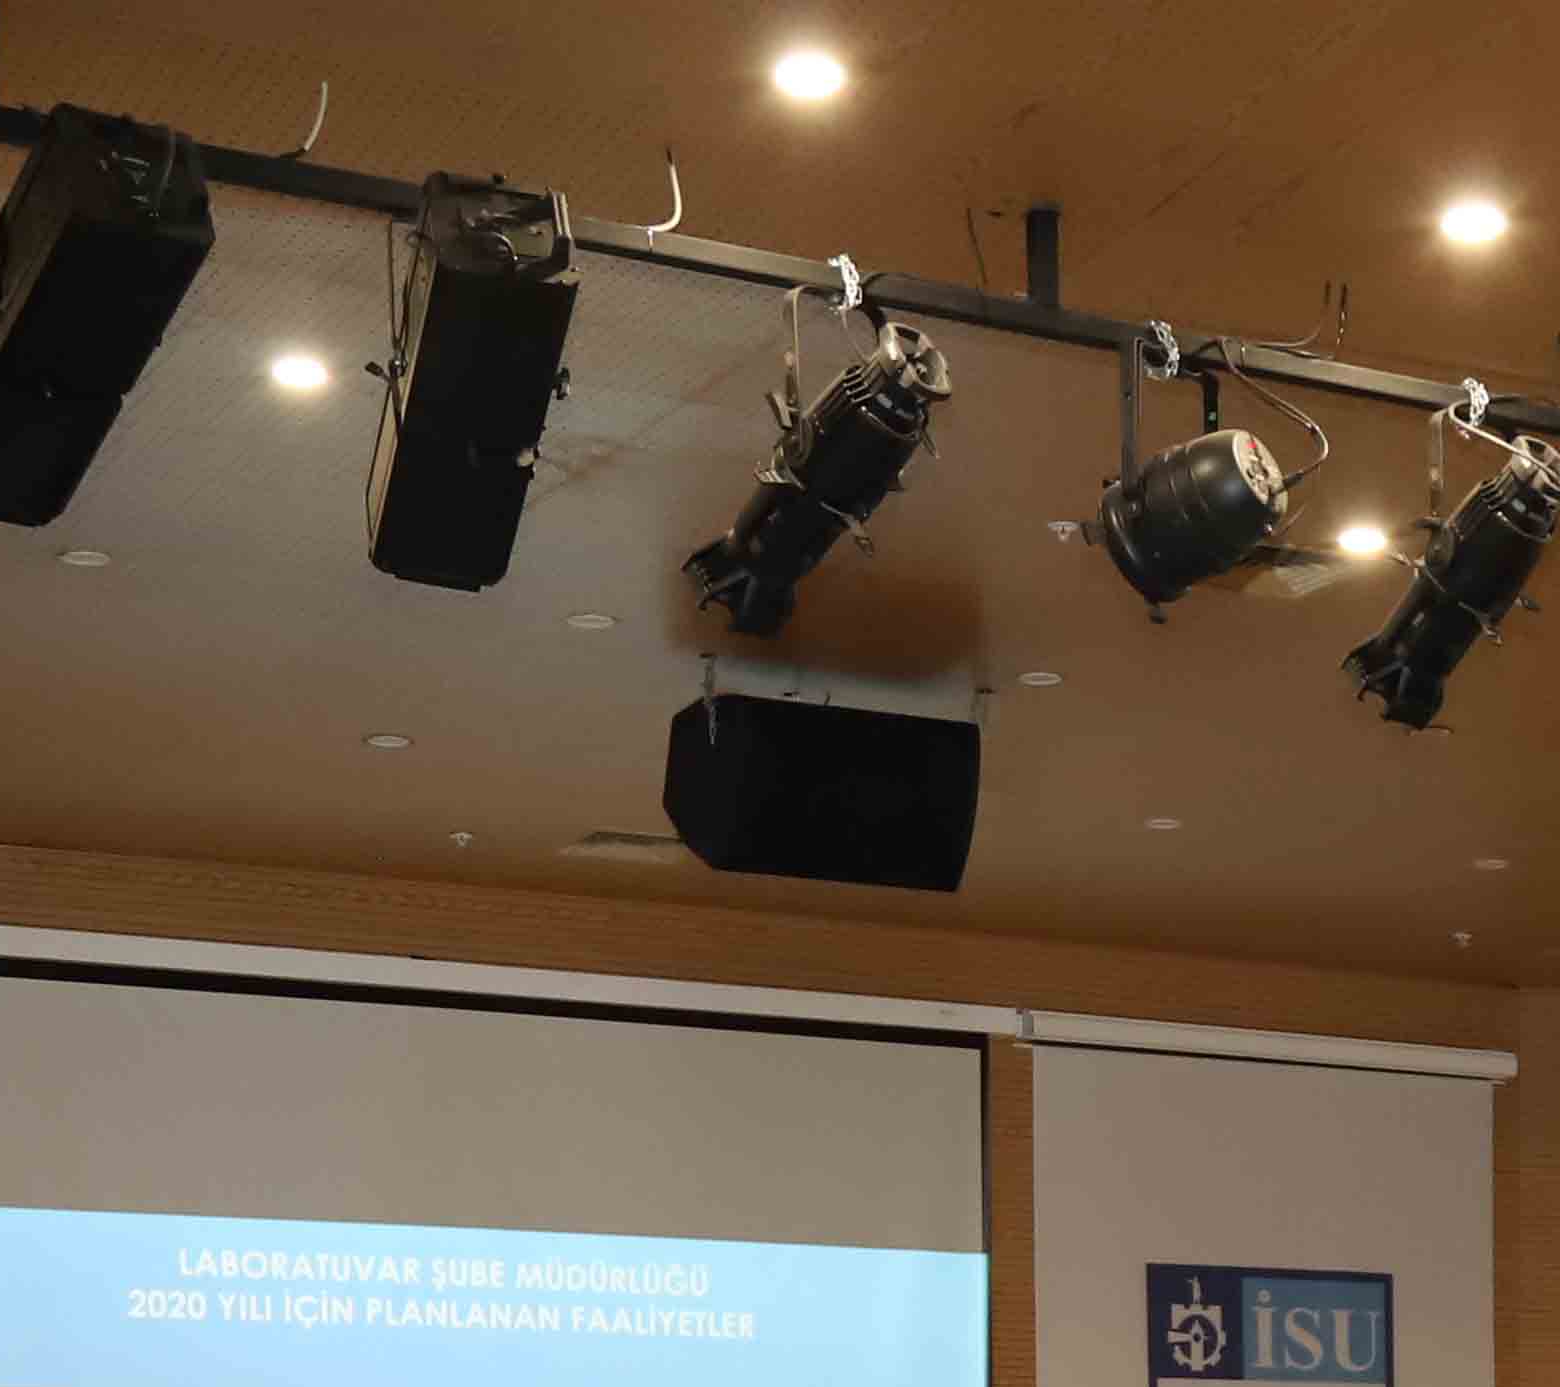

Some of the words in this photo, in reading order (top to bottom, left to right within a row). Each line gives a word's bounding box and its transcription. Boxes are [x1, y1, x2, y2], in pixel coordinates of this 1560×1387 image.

[179, 1249, 423, 1286] LABORATUVAR
[432, 1258, 505, 1295] ŞUBE
[517, 1259, 708, 1296] MÜDÜRLÜĞÜ
[128, 1290, 207, 1320] 2020
[217, 1293, 271, 1322] YILI
[283, 1290, 352, 1330] İÇİN
[366, 1299, 560, 1332] PLANLANAN
[572, 1303, 755, 1341] FAALİYETLER
[1252, 1289, 1383, 1372] İSU
